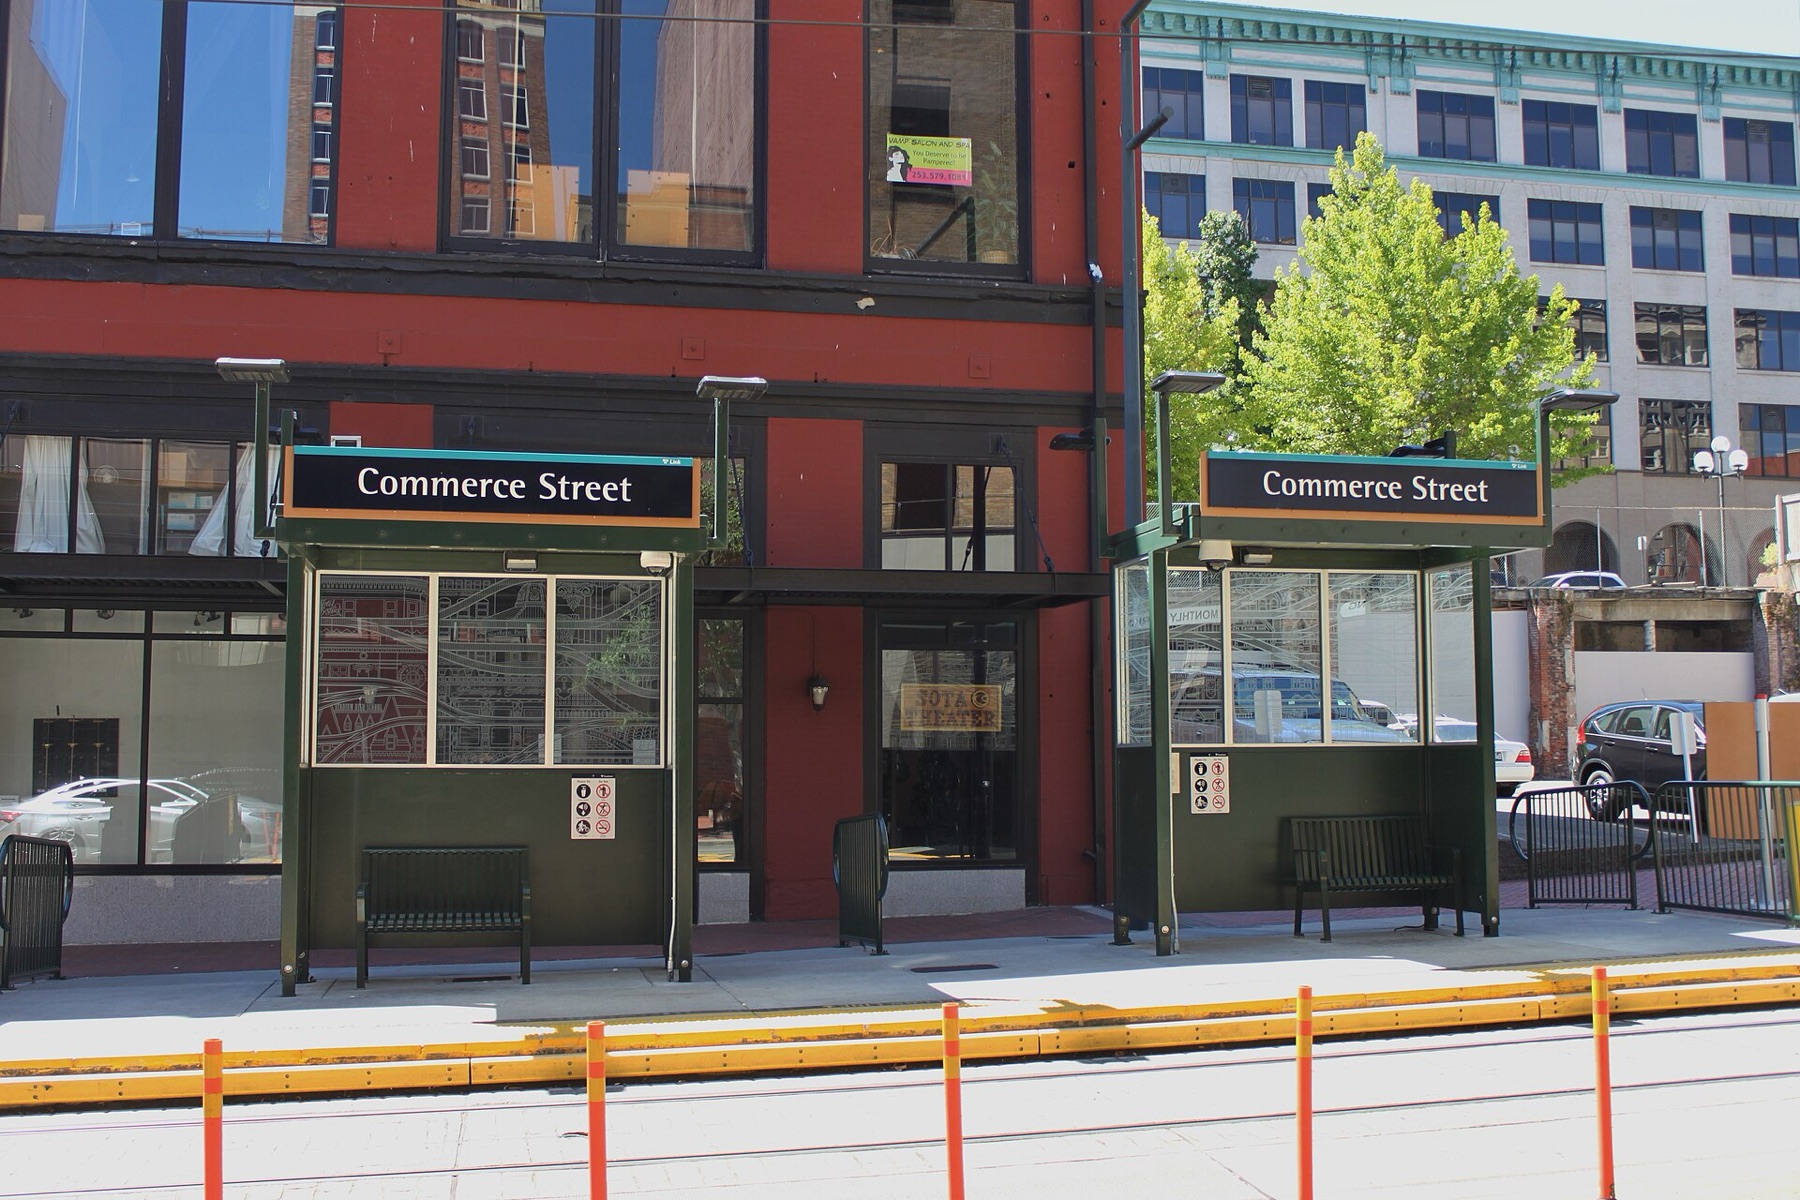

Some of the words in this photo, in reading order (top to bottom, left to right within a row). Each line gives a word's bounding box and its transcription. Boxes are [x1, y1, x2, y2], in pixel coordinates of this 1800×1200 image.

[911, 139, 937, 147] SALON
[938, 140, 954, 148] AND
[955, 141, 970, 149] SPA
[912, 149, 924, 157] You
[925, 150, 949, 158] Deserve
[358, 467, 526, 499] Commerce
[538, 472, 632, 502] Street
[1263, 470, 1402, 500] Commerce
[1412, 475, 1488, 502] Street
[917, 689, 968, 708] SOTA
[905, 709, 995, 727] THEATER
